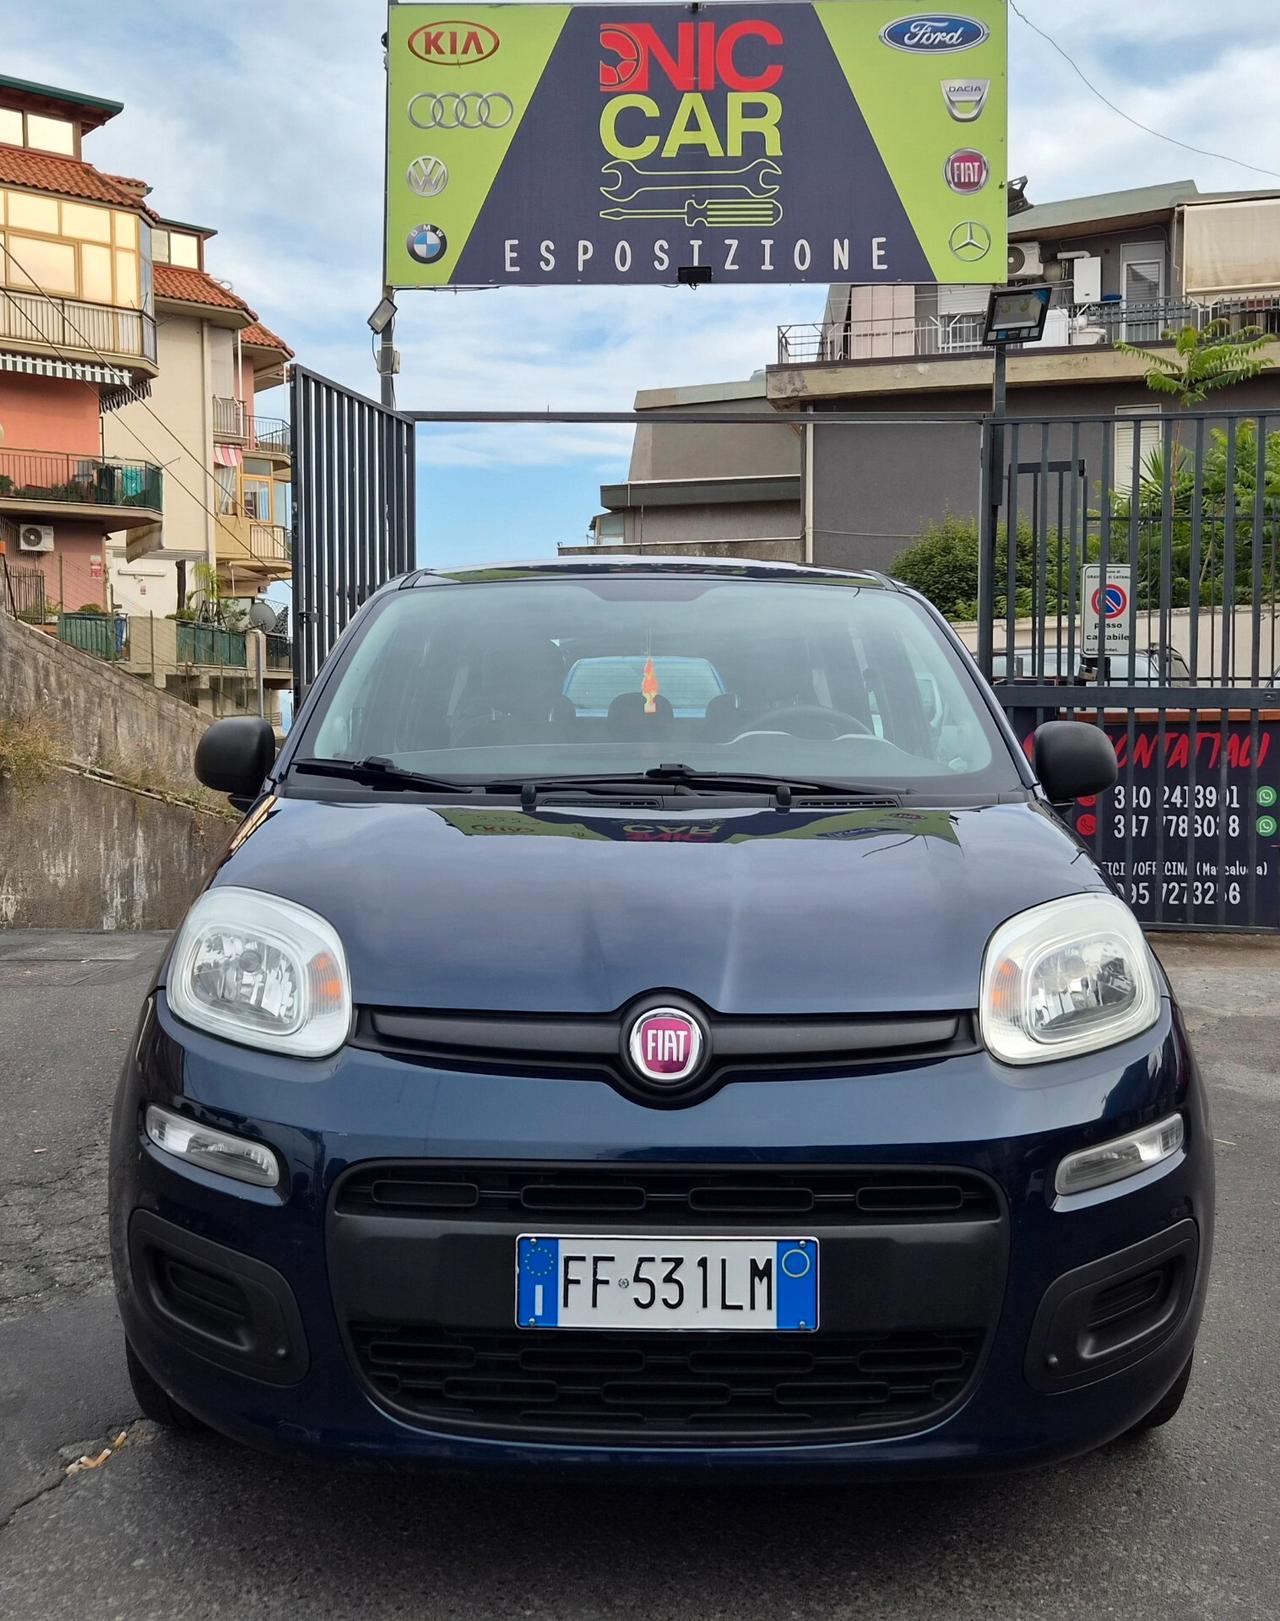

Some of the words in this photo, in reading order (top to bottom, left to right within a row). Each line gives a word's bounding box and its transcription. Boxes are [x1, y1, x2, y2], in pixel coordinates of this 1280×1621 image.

[424, 31, 484, 55] KIA
[904, 21, 964, 45] Ford
[948, 85, 982, 93] DACIA
[600, 92, 784, 161] CAR
[953, 162, 980, 183] FIAT
[504, 236, 889, 272] ESPOSIZIONE
[1086, 633, 1130, 641] caabile
[1094, 622, 1122, 630] psso
[647, 1029, 688, 1062] FIAT
